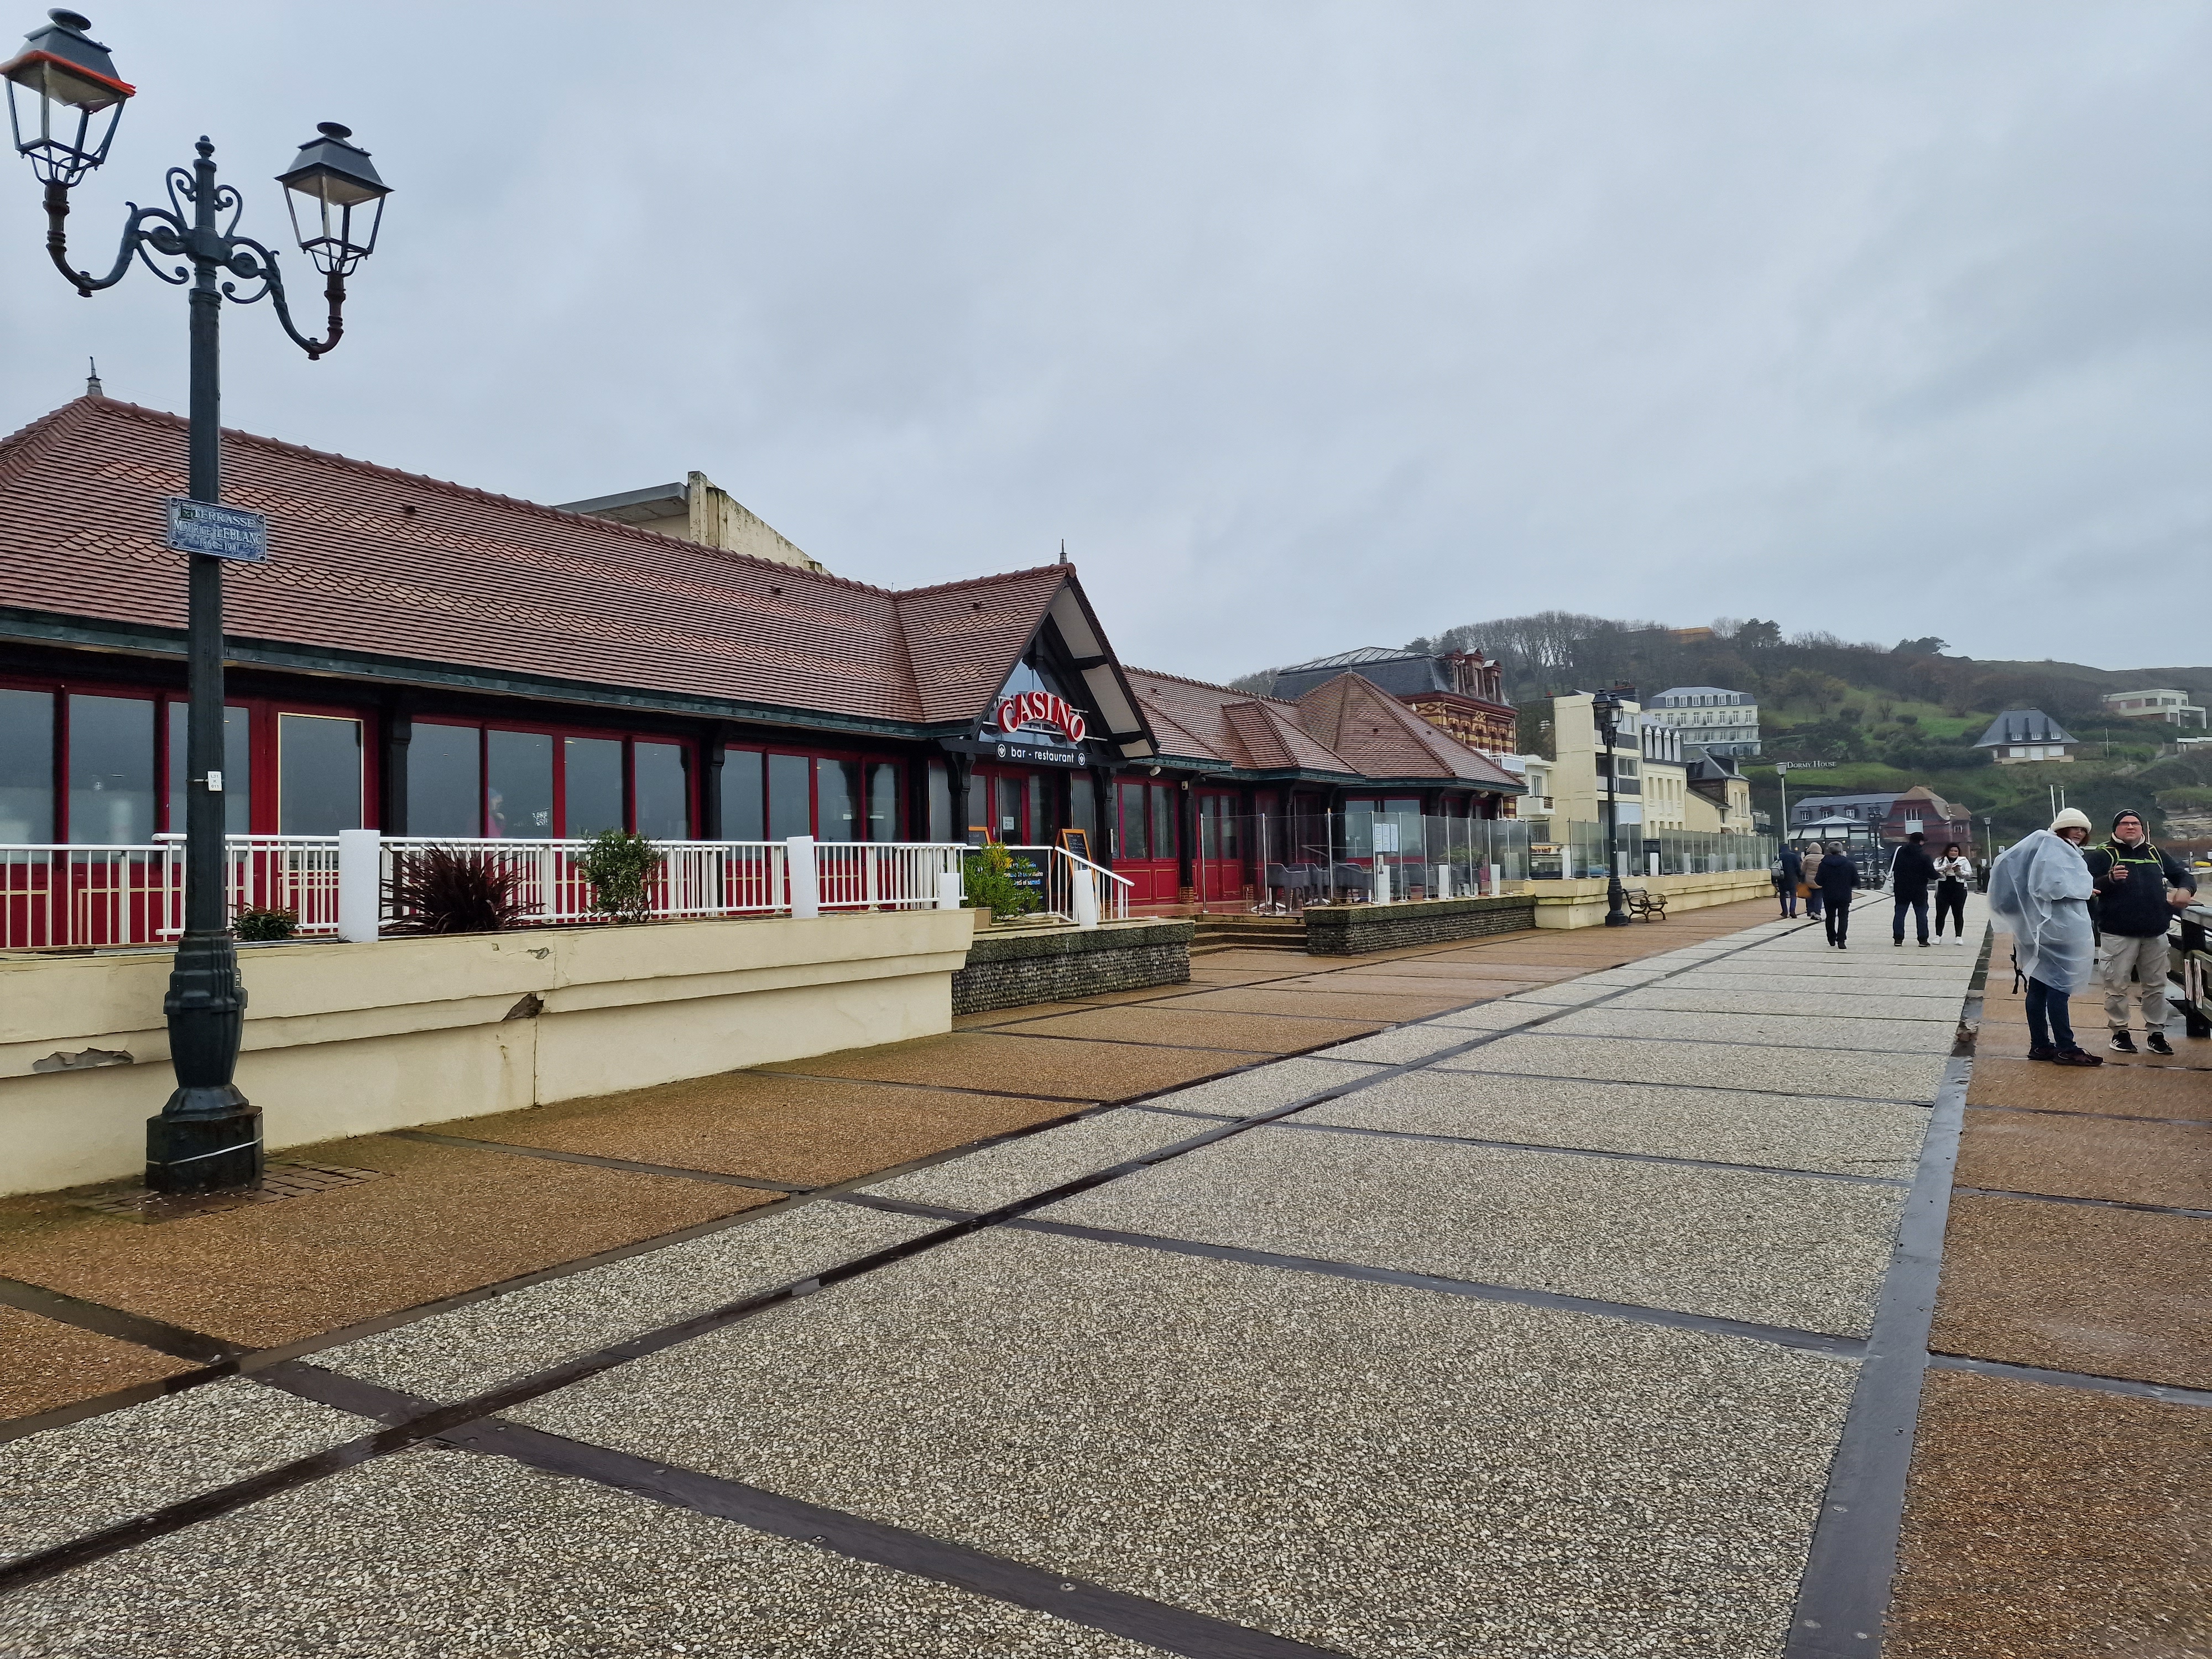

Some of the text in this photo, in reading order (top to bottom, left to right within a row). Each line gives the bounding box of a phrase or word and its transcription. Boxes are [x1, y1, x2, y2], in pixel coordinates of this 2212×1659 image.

[193, 508, 255, 528] TERRASSE
[173, 518, 263, 545] MAURICE LEBLANC
[999, 691, 1086, 742] CASINO
[1011, 746, 1025, 759] bar
[1034, 750, 1074, 763] restaurant
